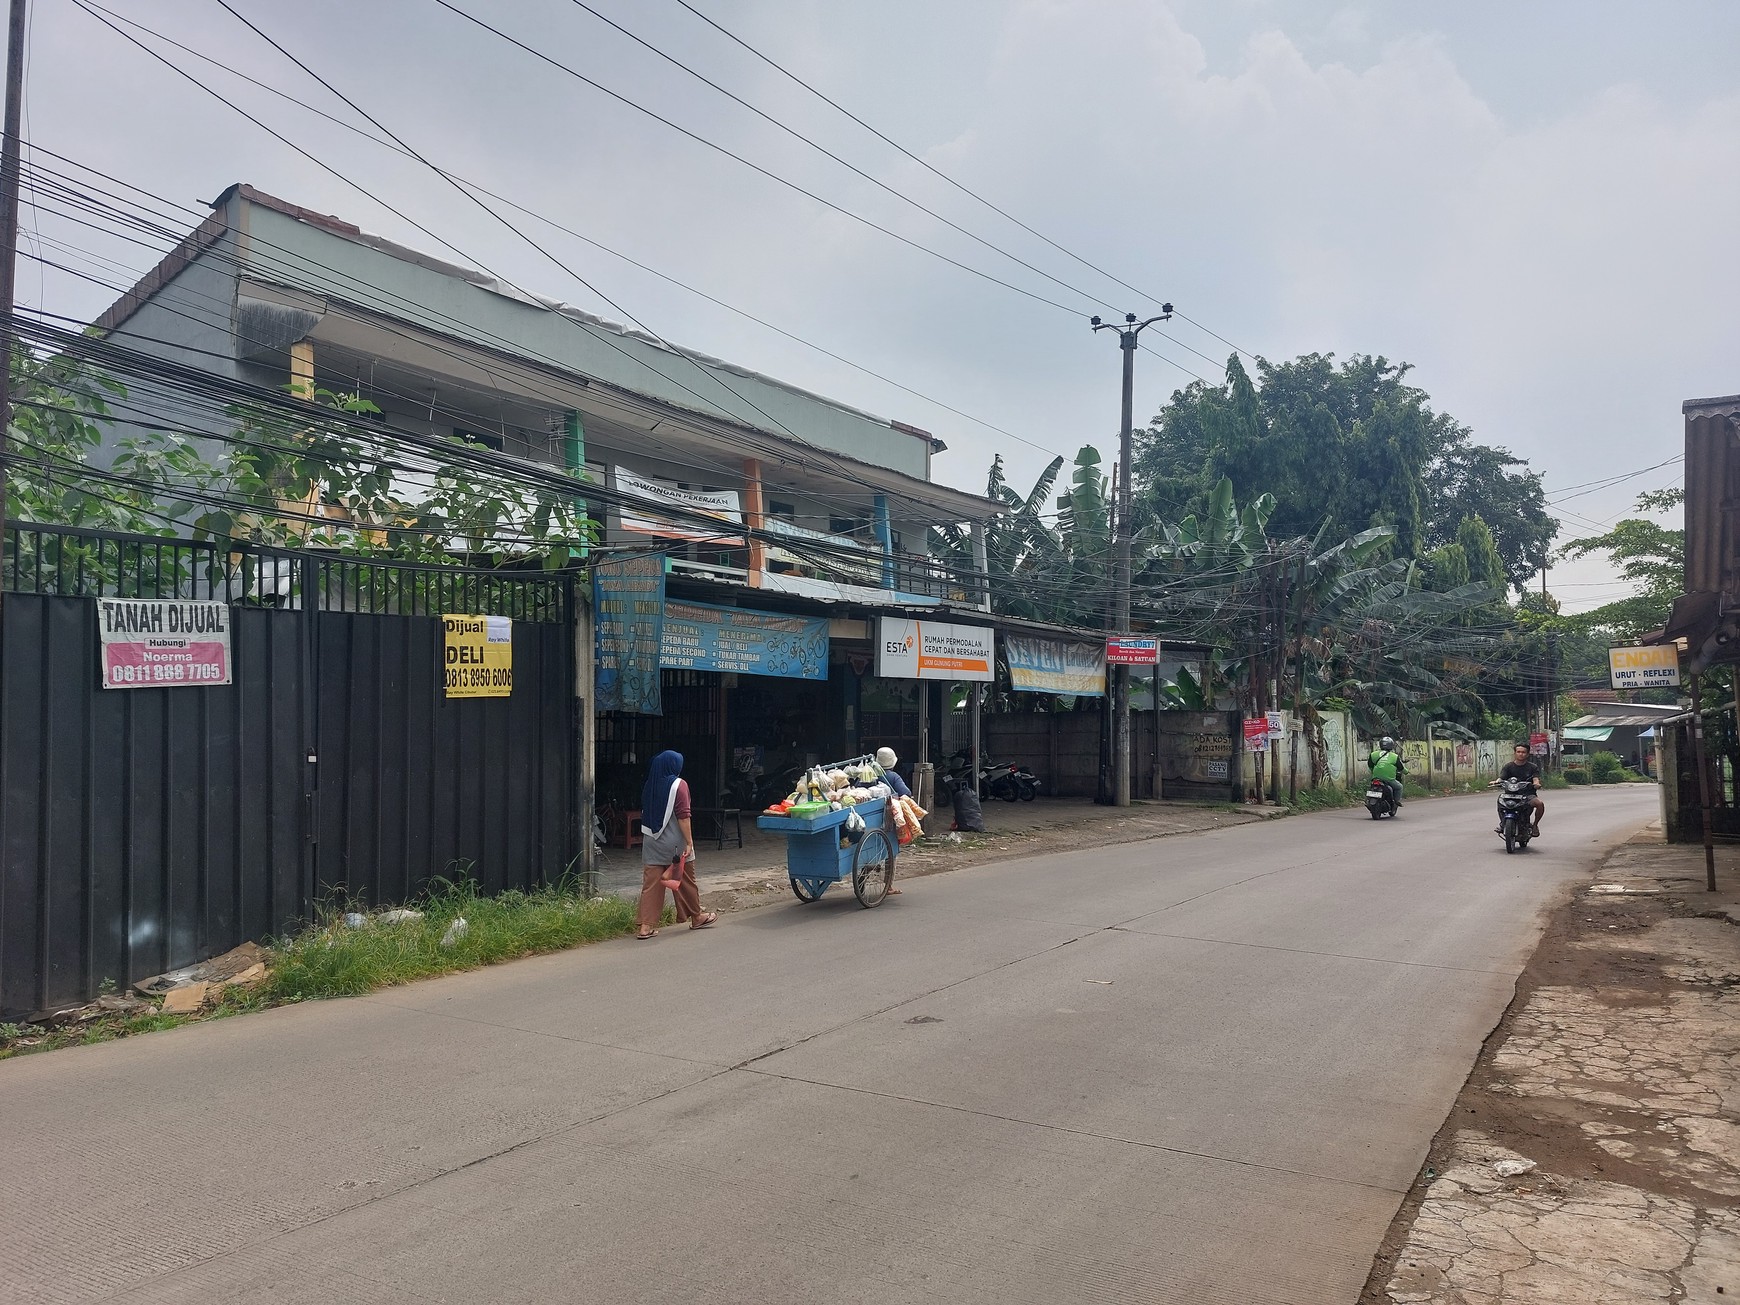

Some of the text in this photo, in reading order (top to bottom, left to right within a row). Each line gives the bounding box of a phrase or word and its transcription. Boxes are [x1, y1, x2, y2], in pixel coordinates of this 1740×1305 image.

[683, 493, 729, 505] PEKERJAAN
[102, 602, 225, 633] TANAH DIJUAL
[446, 620, 483, 636] Dijual
[149, 639, 186, 648] Hubungi
[683, 637, 699, 646] BARU
[718, 641, 731, 650] JUAL
[735, 641, 748, 651] BELI
[886, 641, 908, 654] ESTA
[924, 635, 982, 648] RUMAH PERMODALAN
[143, 652, 193, 662] Noerma
[446, 646, 484, 664] DELI
[682, 647, 706, 657] SECOND
[718, 650, 760, 662] TUKAR TAMBAH
[924, 645, 990, 658] CEPAT DAN BERSAHABAT
[1007, 635, 1061, 669] SEVEN
[678, 657, 694, 666] PART
[1612, 649, 1676, 669] ENDAH
[112, 663, 220, 682] 0811 888 7705
[446, 668, 512, 688] 0813 8950 6006
[1615, 671, 1637, 679] URUT
[1643, 669, 1675, 678] REFLEXI
